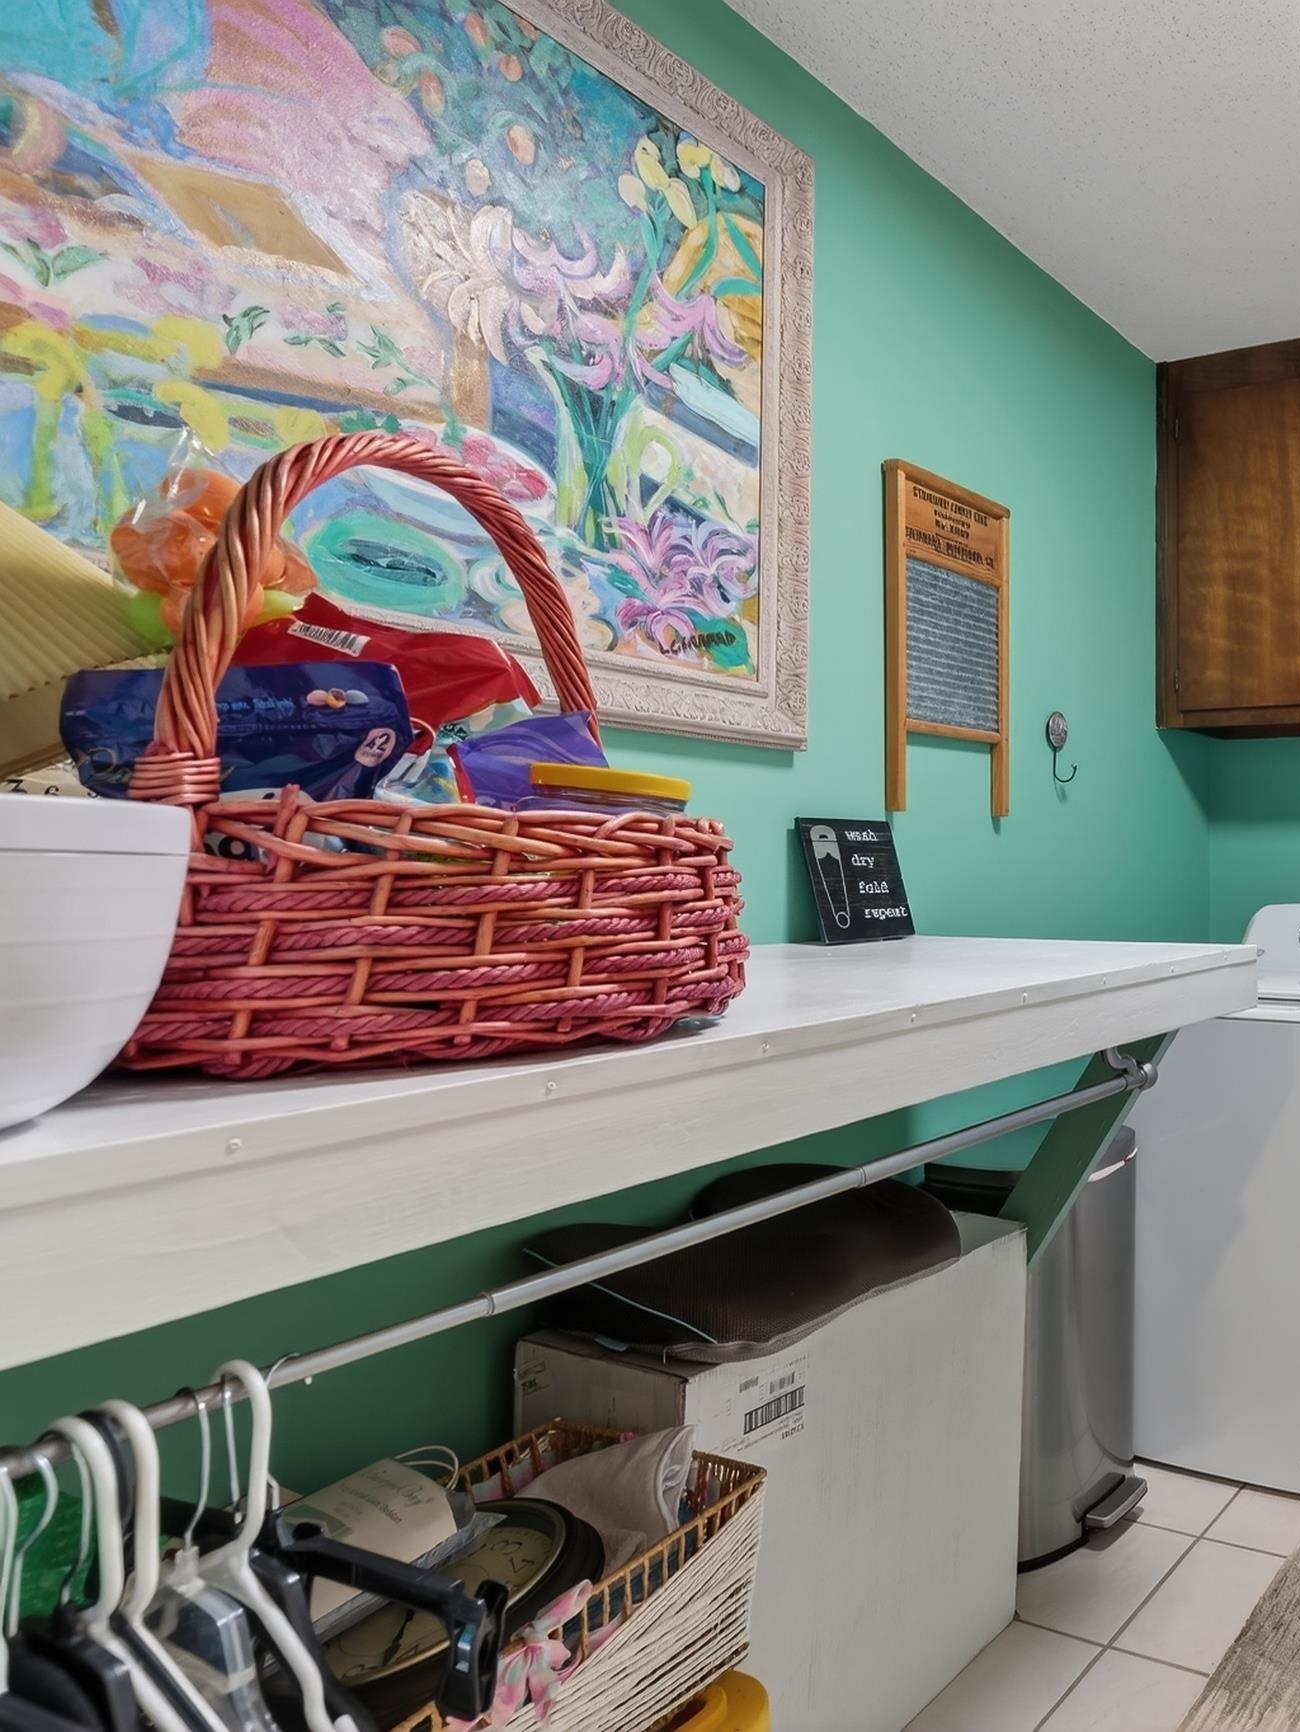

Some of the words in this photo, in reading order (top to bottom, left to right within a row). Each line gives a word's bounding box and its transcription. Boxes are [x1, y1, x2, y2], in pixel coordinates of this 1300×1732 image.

[844, 829, 878, 841] wash
[851, 854, 875, 868] dry
[864, 906, 909, 920] repeat
